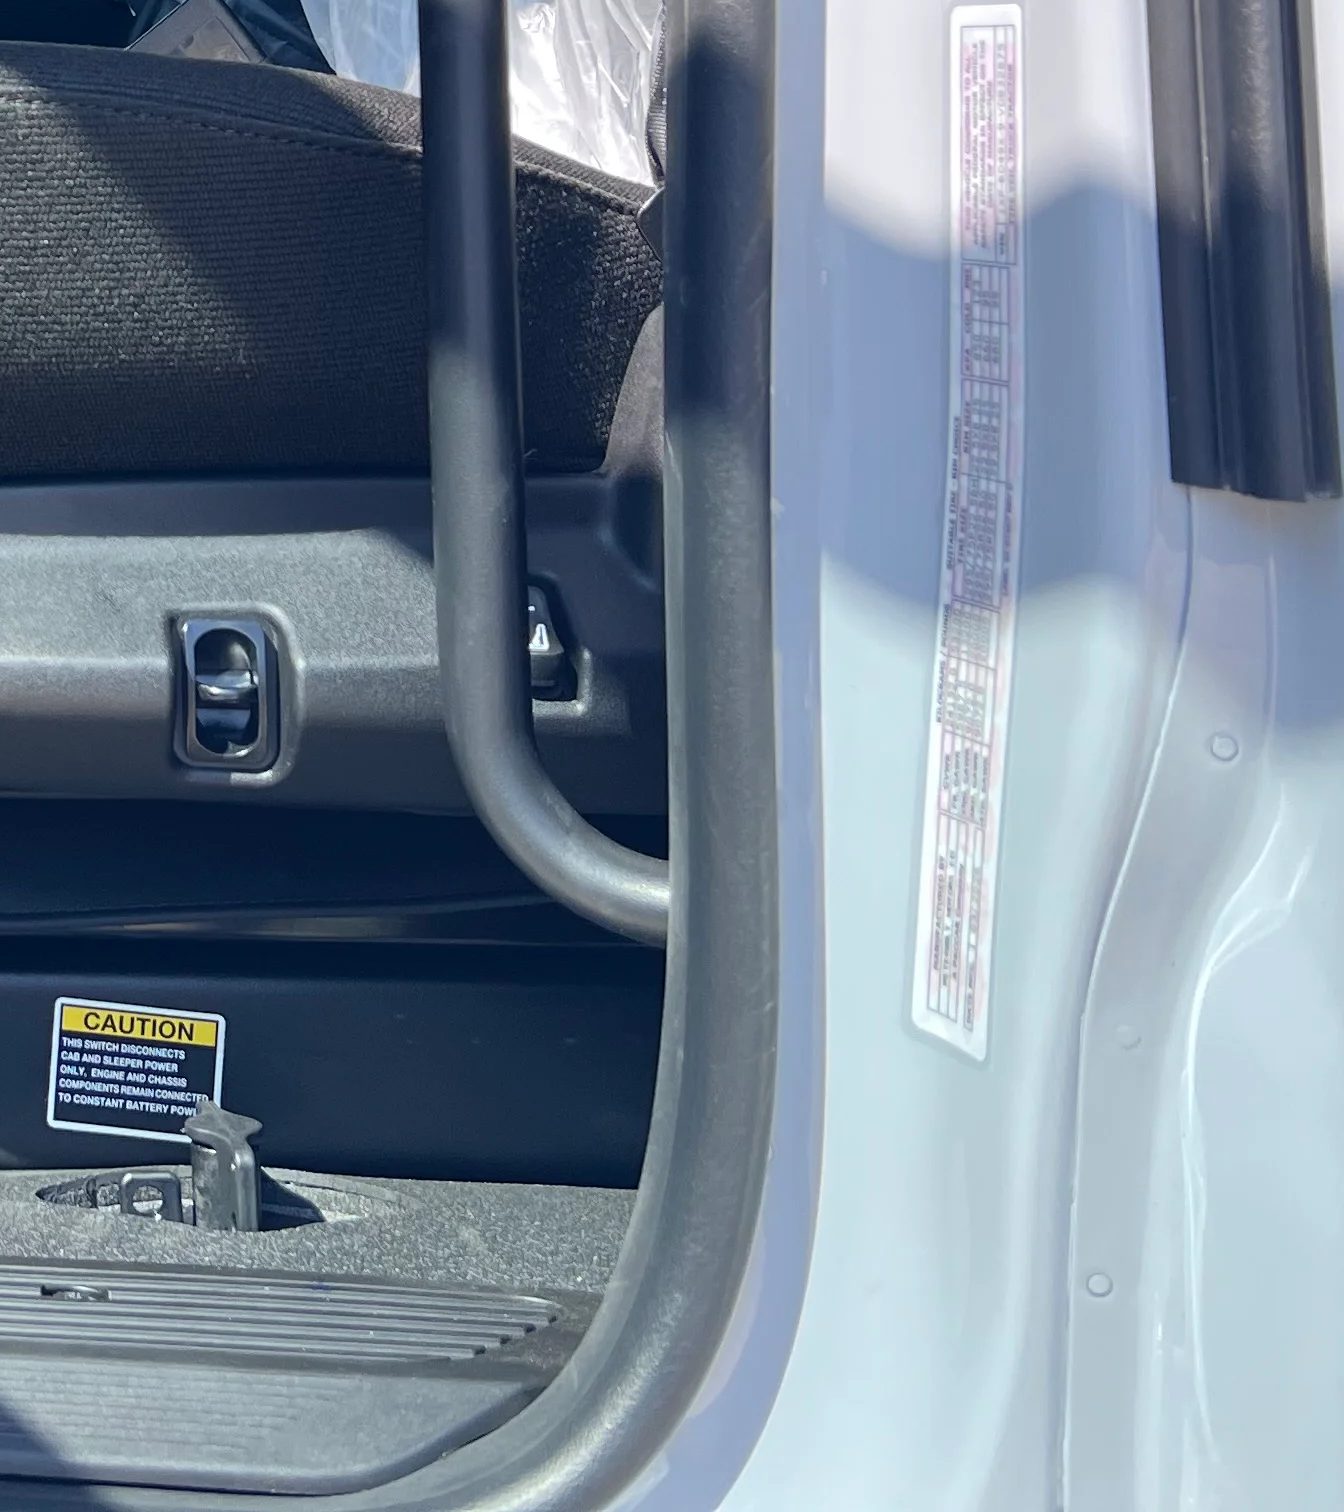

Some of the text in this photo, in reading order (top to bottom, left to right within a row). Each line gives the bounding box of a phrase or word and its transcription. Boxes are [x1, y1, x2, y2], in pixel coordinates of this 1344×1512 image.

[84, 1012, 194, 1041] CAUTION
[62, 1037, 185, 1059] THIS SWITCH DISCONNECTS
[61, 1051, 177, 1072] CAB AND SLEEPER POWER
[91, 1068, 124, 1080] ENGINE
[127, 1072, 145, 1083] AND
[148, 1074, 186, 1087] CHASSIS
[59, 1078, 208, 1103] COMPONENTS REMAIN CONNECTED
[58, 1093, 71, 1102] TO
[73, 1094, 123, 1108] CONSTANT
[126, 1100, 168, 1113] BATTERY
